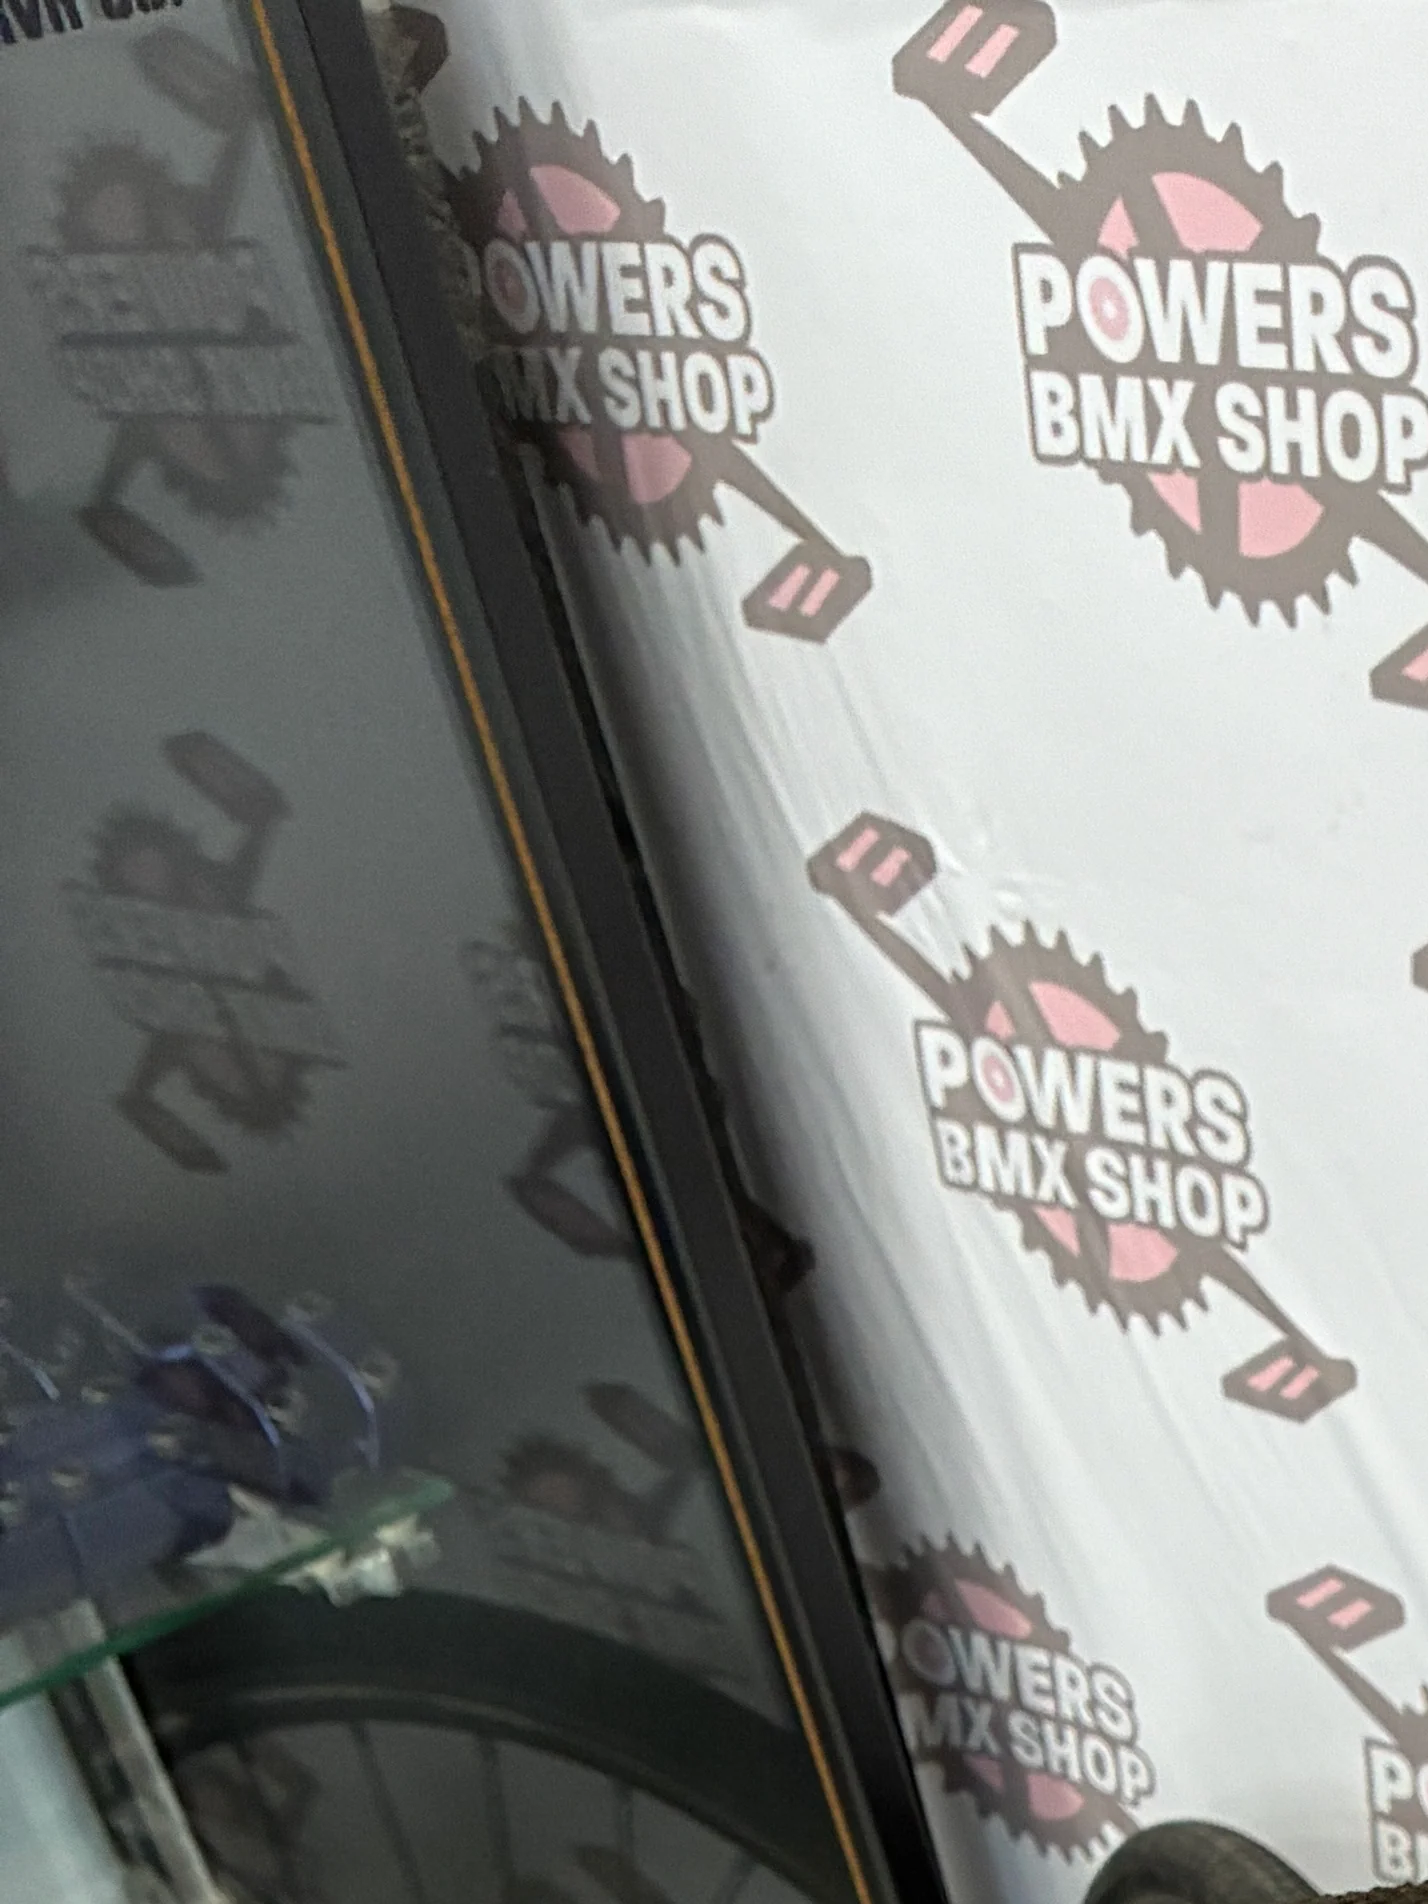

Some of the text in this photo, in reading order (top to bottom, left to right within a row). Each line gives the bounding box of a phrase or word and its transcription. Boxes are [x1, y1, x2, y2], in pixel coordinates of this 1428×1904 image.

[1017, 250, 1416, 379] POWERS
[598, 346, 773, 436] SHOP
[1029, 369, 1201, 469] BMX
[917, 1023, 1248, 1165] POWERS
[935, 1117, 1267, 1244] BMX SHOP
[898, 1690, 1149, 1801] MX SHOP
